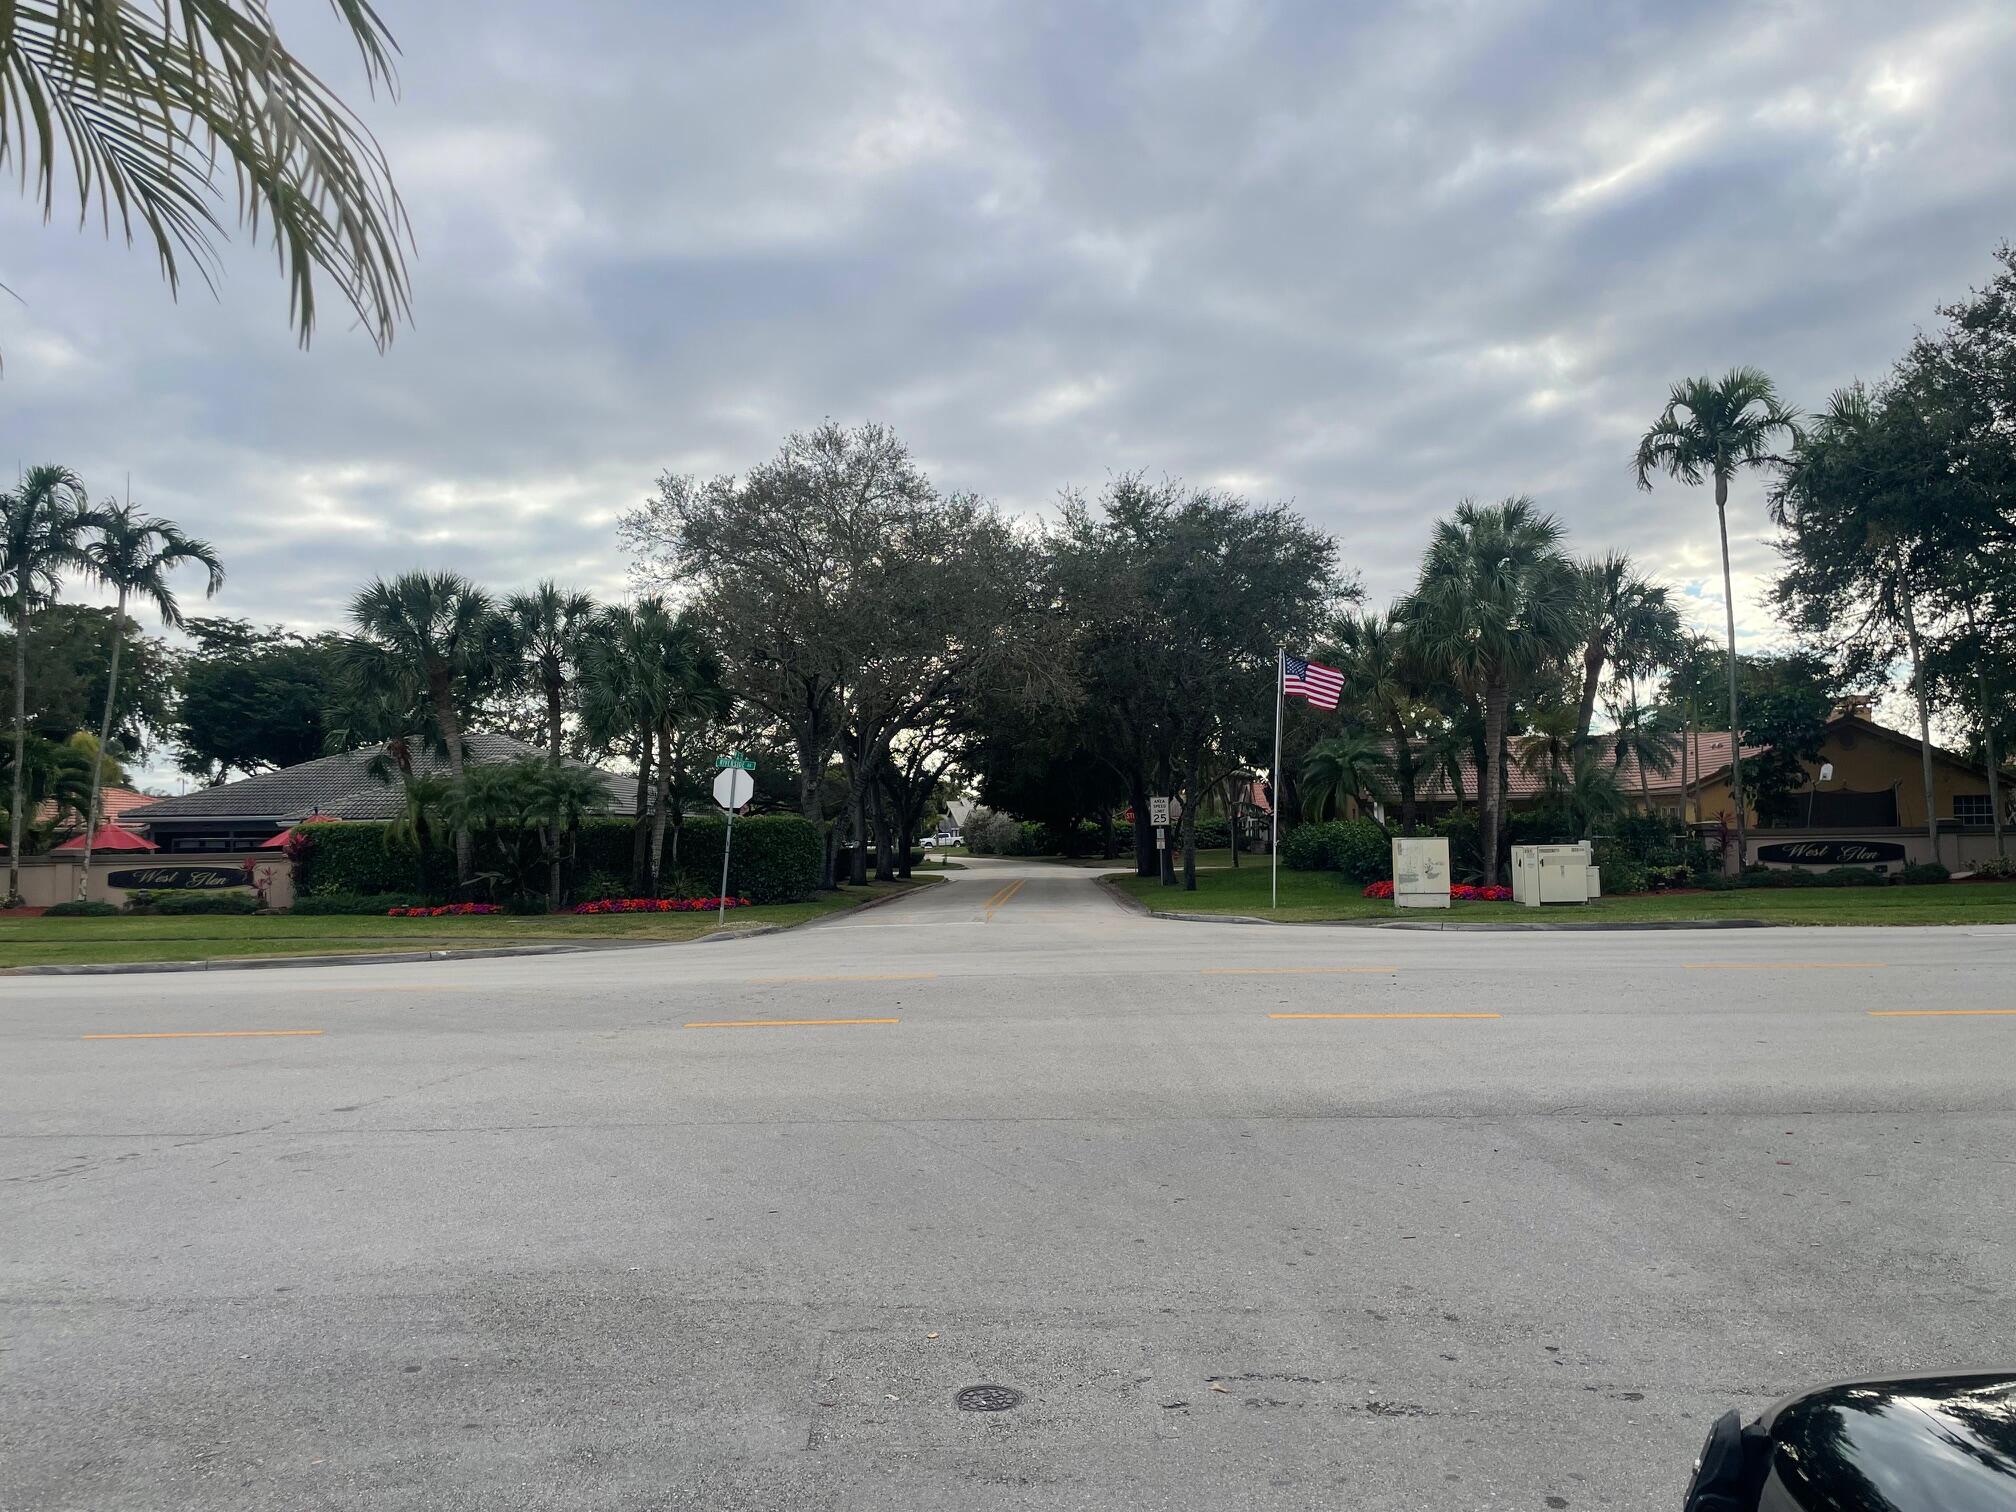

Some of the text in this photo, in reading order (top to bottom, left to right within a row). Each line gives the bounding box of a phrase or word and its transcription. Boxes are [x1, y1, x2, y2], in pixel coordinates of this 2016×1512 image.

[719, 759, 744, 768] RIVERSIDE
[1153, 813, 1167, 823] 25
[1782, 844, 1880, 862] West Glen
[133, 868, 229, 888] West Glen
